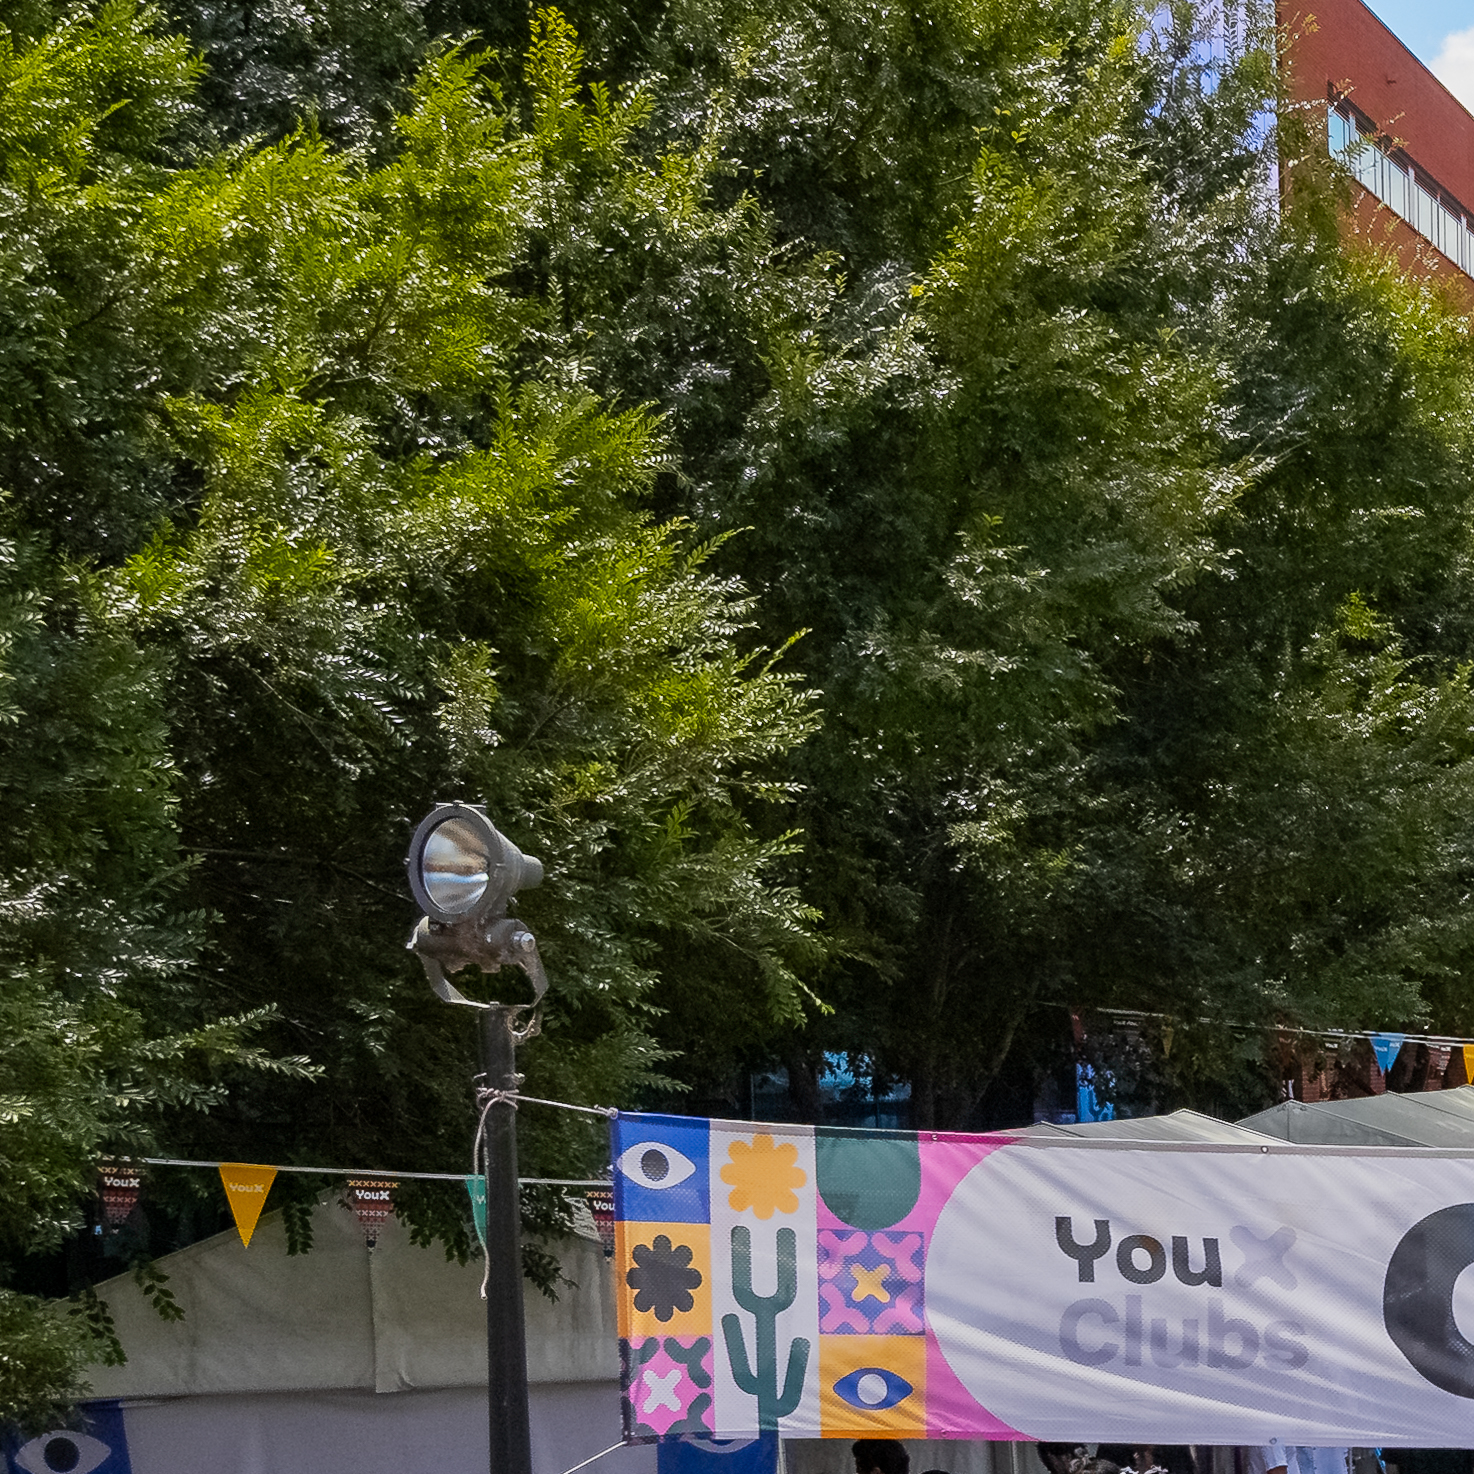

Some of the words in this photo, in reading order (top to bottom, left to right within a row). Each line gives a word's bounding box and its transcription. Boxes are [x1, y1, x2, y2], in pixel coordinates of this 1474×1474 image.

[104, 1177, 140, 1188] YouX
[229, 1183, 264, 1192] YouX
[355, 1189, 391, 1201] YouX
[593, 1200, 615, 1211] You
[1059, 1294, 1310, 1371] Clubs
